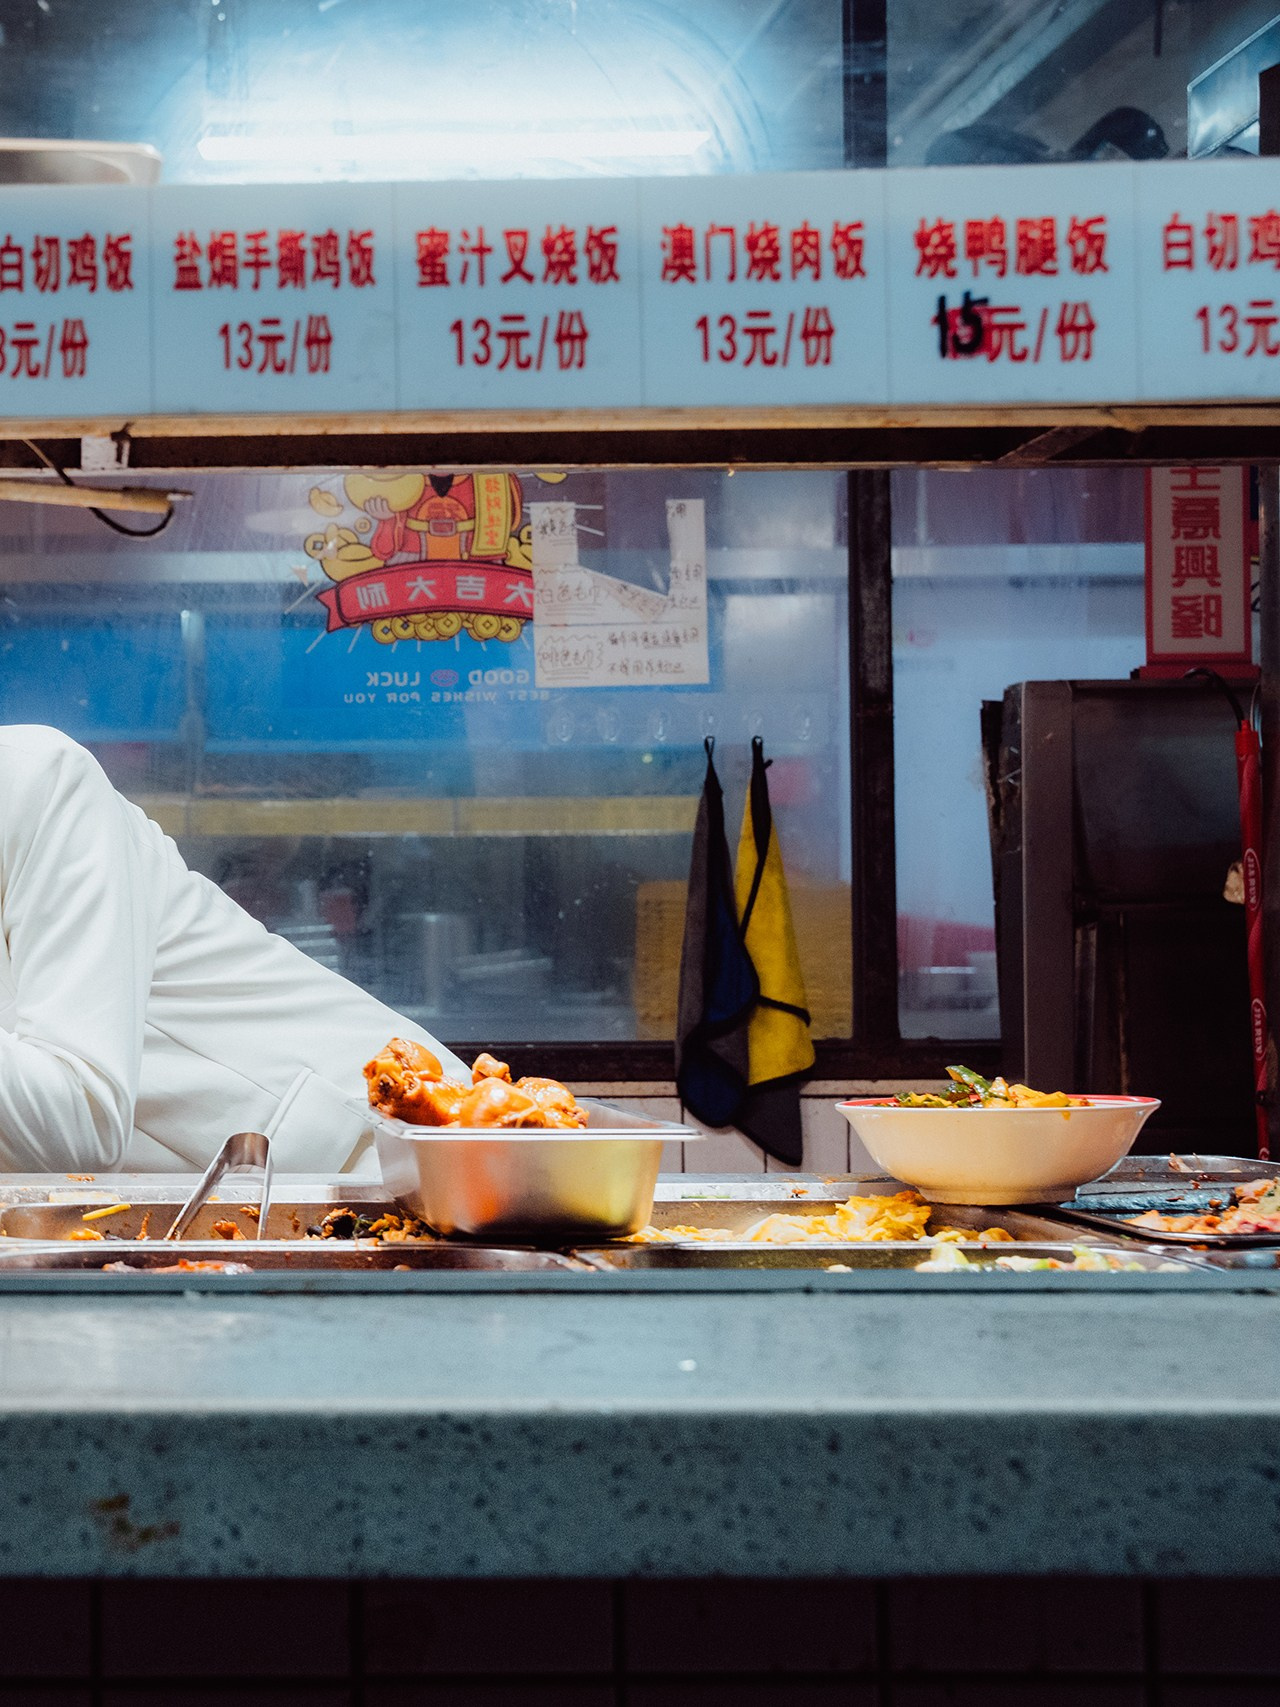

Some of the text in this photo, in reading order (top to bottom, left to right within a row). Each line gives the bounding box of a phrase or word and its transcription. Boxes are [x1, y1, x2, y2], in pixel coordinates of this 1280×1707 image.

[173, 229, 375, 291] 盐焗手撕鸡饭
[416, 224, 620, 287] 蜜汁叉烧饭
[660, 220, 866, 284] 澳门烧肉饭
[913, 215, 1109, 278] 烧鸭腿饭
[219, 315, 333, 374] 13元/份
[450, 310, 589, 371] 13元/份
[696, 306, 835, 367] 13元/份
[1196, 300, 1280, 357] 13元
